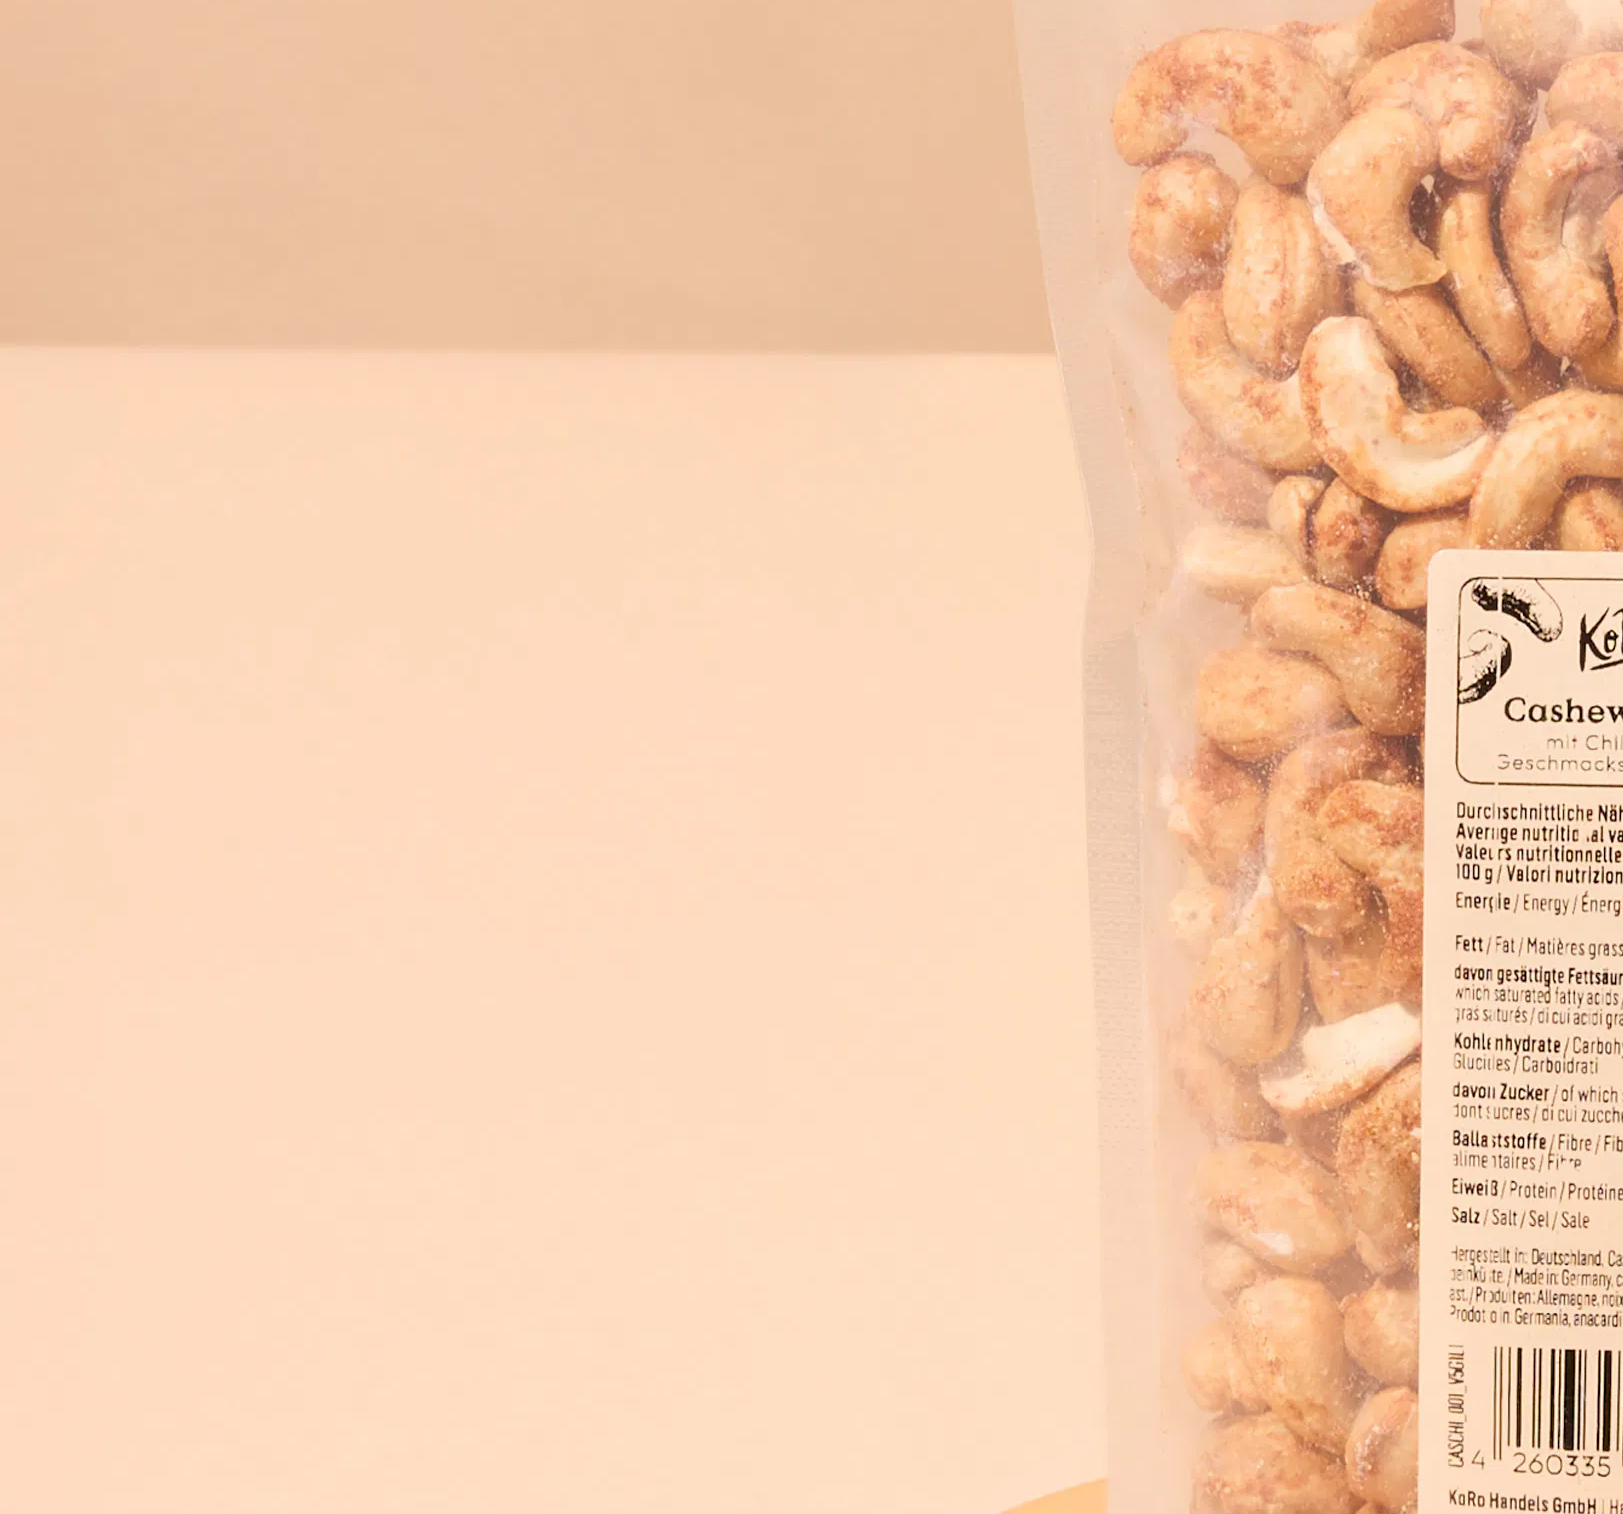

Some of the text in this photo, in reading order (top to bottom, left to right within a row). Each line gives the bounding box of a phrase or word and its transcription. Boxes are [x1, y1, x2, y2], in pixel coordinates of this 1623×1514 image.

[1547, 736, 1577, 749] mit
[1457, 864, 1480, 880] 100
[1507, 865, 1550, 882] Valori
[1524, 894, 1569, 916] Energy
[1456, 935, 1483, 952] Fett
[1496, 936, 1515, 953] Fat
[1527, 938, 1585, 956] Matières
[1455, 965, 1492, 981] davon
[1497, 966, 1564, 987] gesättigte
[1500, 1083, 1549, 1101] Zucker
[1561, 1085, 1574, 1102] of
[1578, 1086, 1618, 1103] which
[1558, 1134, 1592, 1151] Fibre
[1452, 1178, 1498, 1196] Eiweiß
[1510, 1180, 1556, 1199] Protein
[1452, 1207, 1590, 1229] Salz Salt Sel Sale
[1471, 1450, 1485, 1469] 4
[1513, 1451, 1610, 1477] 260335
[1449, 1490, 1485, 1507] KoRo
[1490, 1493, 1548, 1512] Handels
[1553, 1497, 1596, 1514] GmbH
